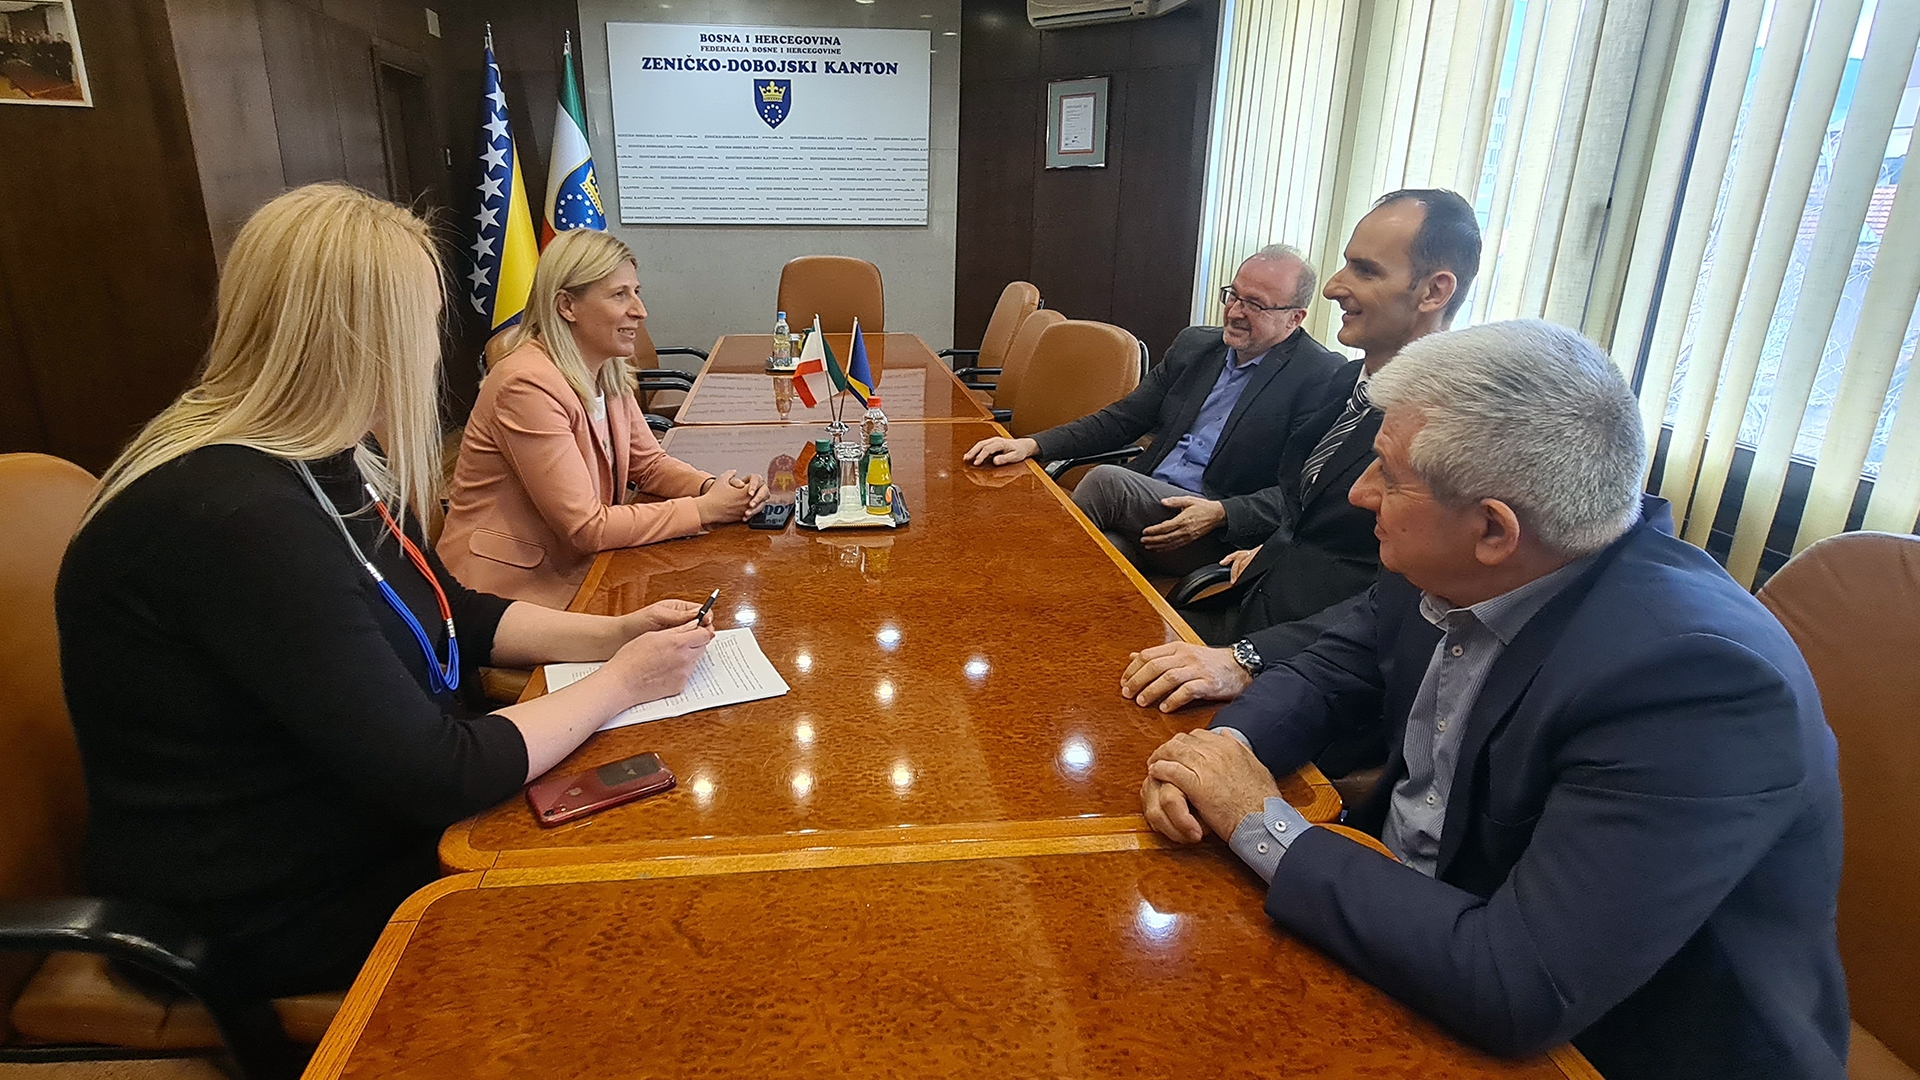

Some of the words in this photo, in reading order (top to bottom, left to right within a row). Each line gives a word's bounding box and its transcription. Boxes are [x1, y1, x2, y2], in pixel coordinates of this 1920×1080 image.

[700, 33, 741, 44] BOSNA
[745, 34, 751, 44] I
[755, 35, 842, 46] HERCEGOVINA
[700, 45, 749, 53] FEDERACIJA
[752, 46, 778, 54] BOSNE
[786, 47, 842, 55] HERCEGOVINE
[641, 55, 818, 74] ZENIČKO-DOBOJSKI
[824, 61, 899, 75] KANTON
